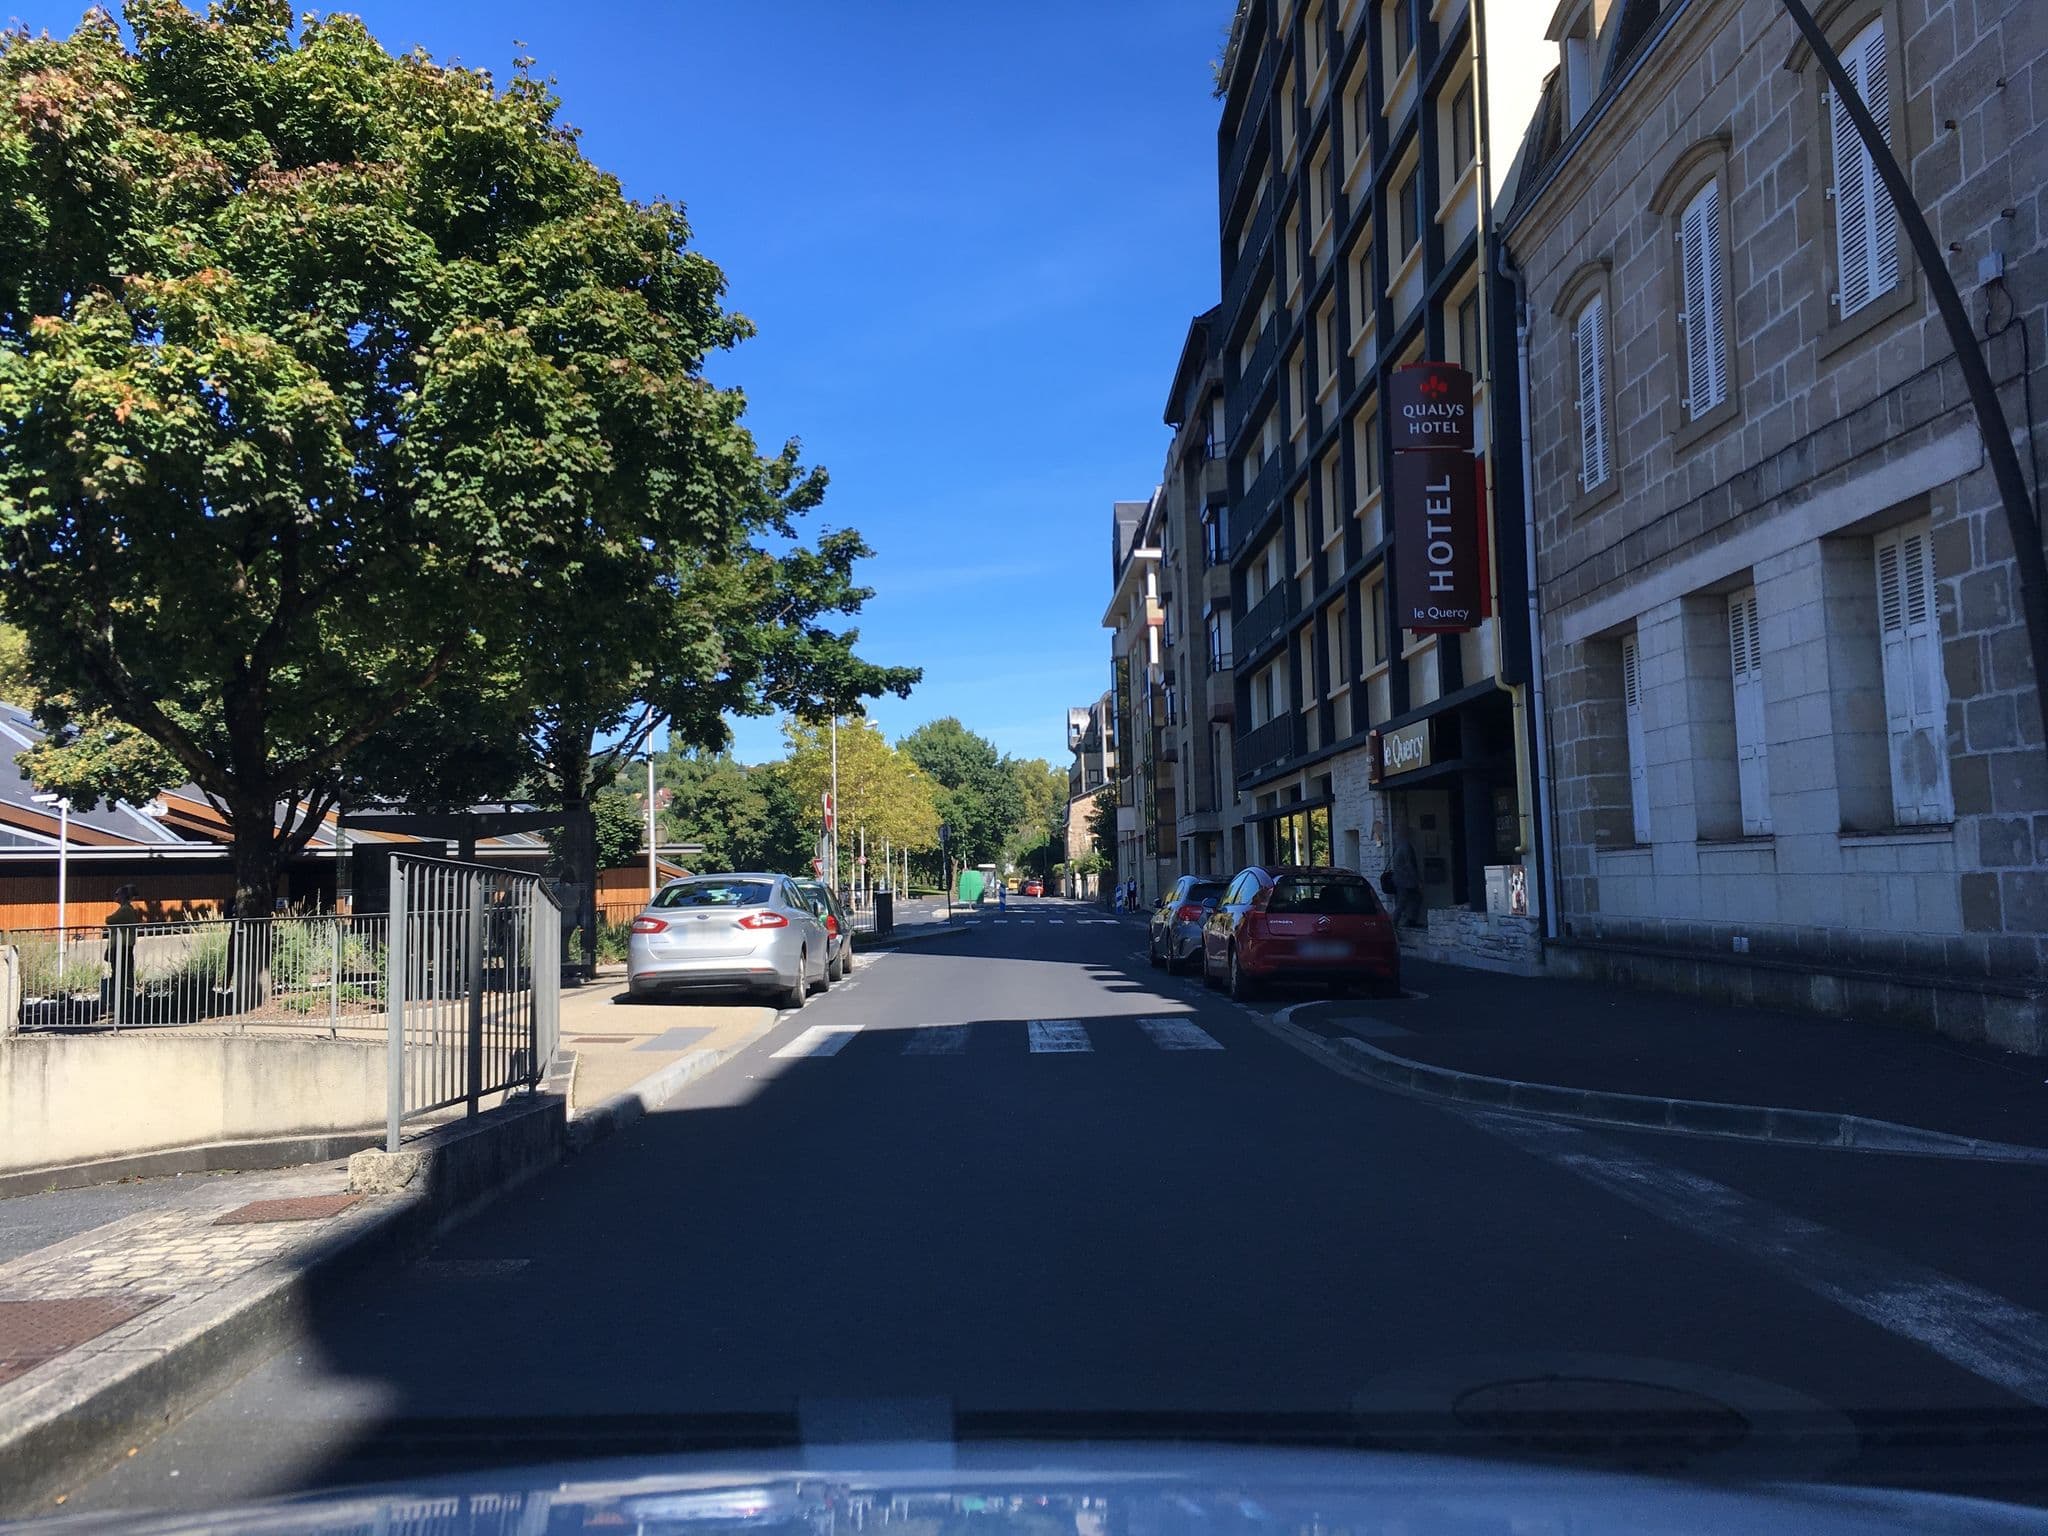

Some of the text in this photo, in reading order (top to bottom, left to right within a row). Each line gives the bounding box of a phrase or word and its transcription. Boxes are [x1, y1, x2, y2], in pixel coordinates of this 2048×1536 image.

[1403, 403, 1464, 417] QUALYS
[1409, 421, 1460, 434] HOTEL
[1426, 474, 1454, 592] HOTEL
[1413, 606, 1469, 620] le Quercy
[1392, 734, 1424, 768] Quercy
